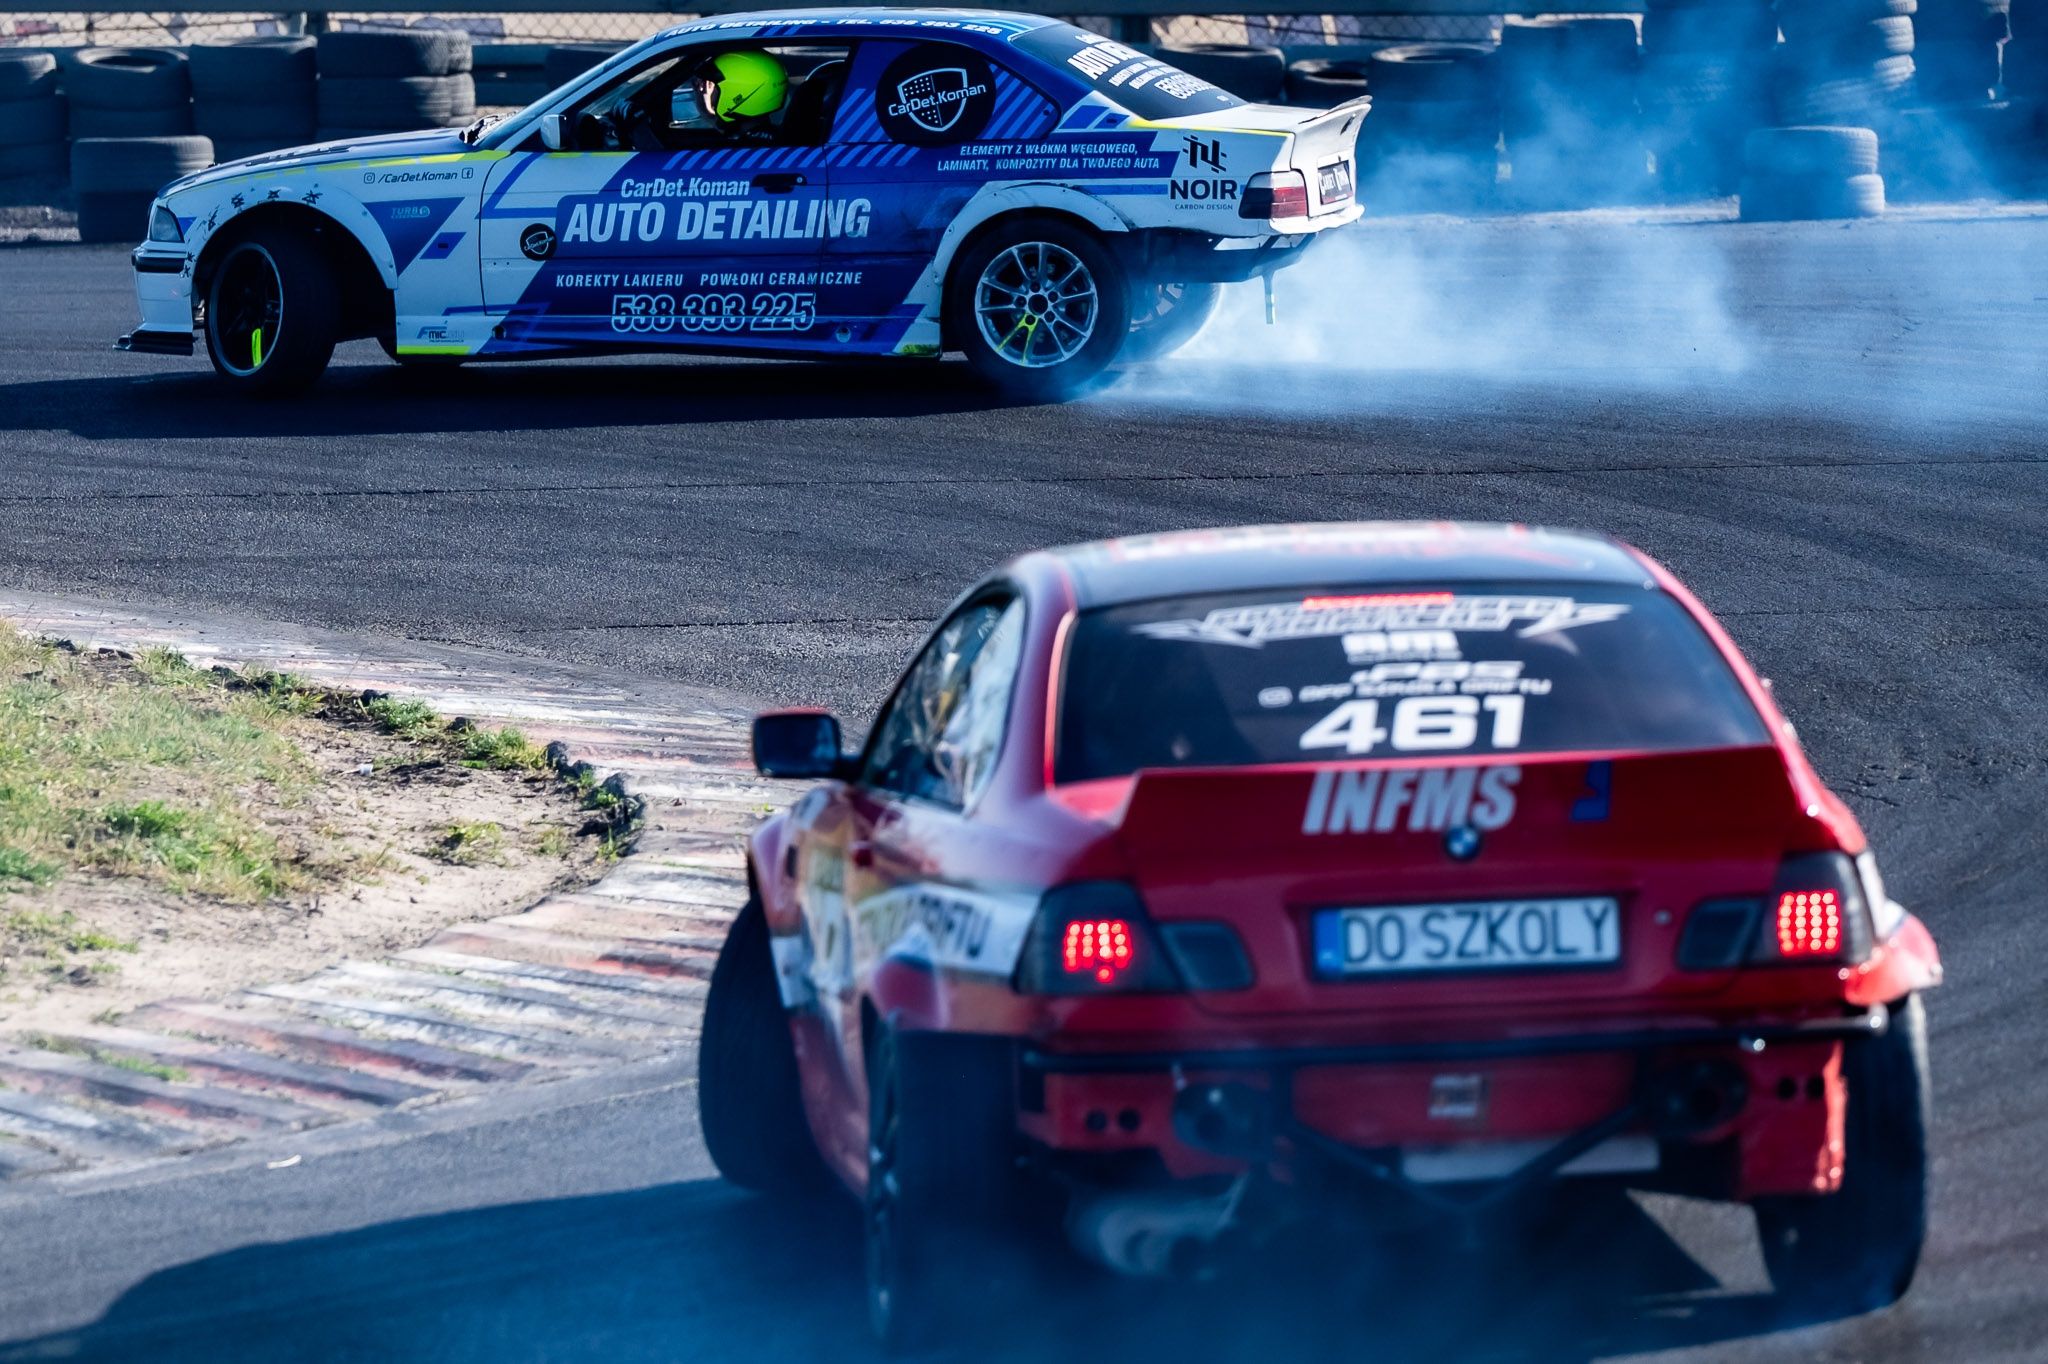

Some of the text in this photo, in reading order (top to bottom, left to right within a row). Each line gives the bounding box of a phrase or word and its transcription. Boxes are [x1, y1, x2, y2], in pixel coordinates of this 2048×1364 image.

[664, 23, 717, 38] AUTO
[718, 18, 818, 29] DETAILING
[888, 83, 987, 117] CarDet.Koman
[960, 142, 1139, 156] ELEMENTY Z WŁÓKNA WĘGLOWEGO,
[937, 157, 1160, 172] LAMINATY, KOMPOZYTY DLA TWOJEGO AUTA
[620, 177, 750, 198] CarDet.Koman
[1169, 179, 1238, 200] NOIR
[562, 198, 872, 243] AUTO DETAILING
[555, 273, 684, 288] KOREKTY LAKIERU
[699, 271, 863, 287] POWŁOKI CERAMICZNE
[611, 292, 817, 333] 538 393 225
[1298, 693, 1526, 755] 461
[1302, 762, 1523, 834] INFMS
[1344, 902, 1609, 965] DO SZKOLY
